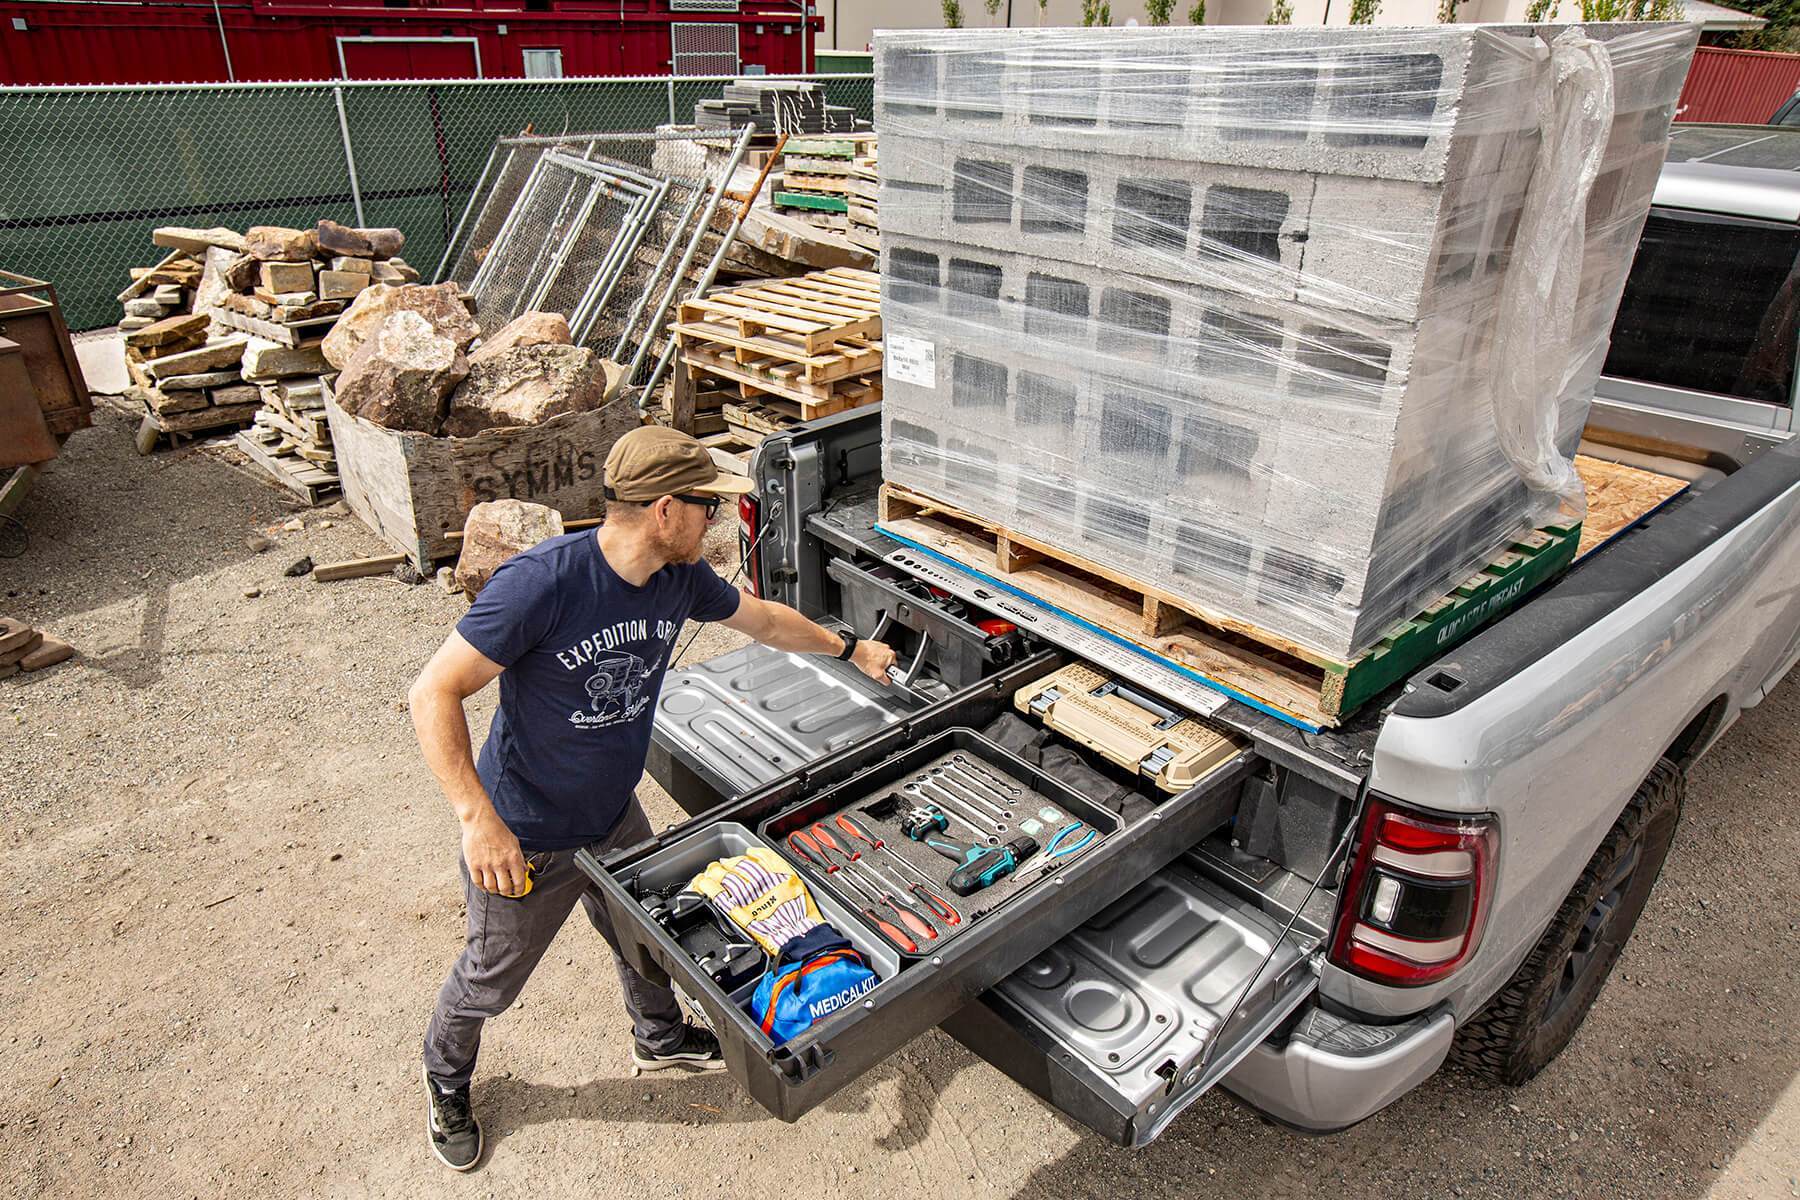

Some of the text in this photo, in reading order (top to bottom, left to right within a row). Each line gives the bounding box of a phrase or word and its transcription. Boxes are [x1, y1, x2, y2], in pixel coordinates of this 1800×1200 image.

[473, 452, 596, 502] SYMMS
[556, 619, 648, 671] EXPEDITION
[751, 895, 777, 917] Kinco
[808, 975, 877, 1018] MEDICAL KIT
